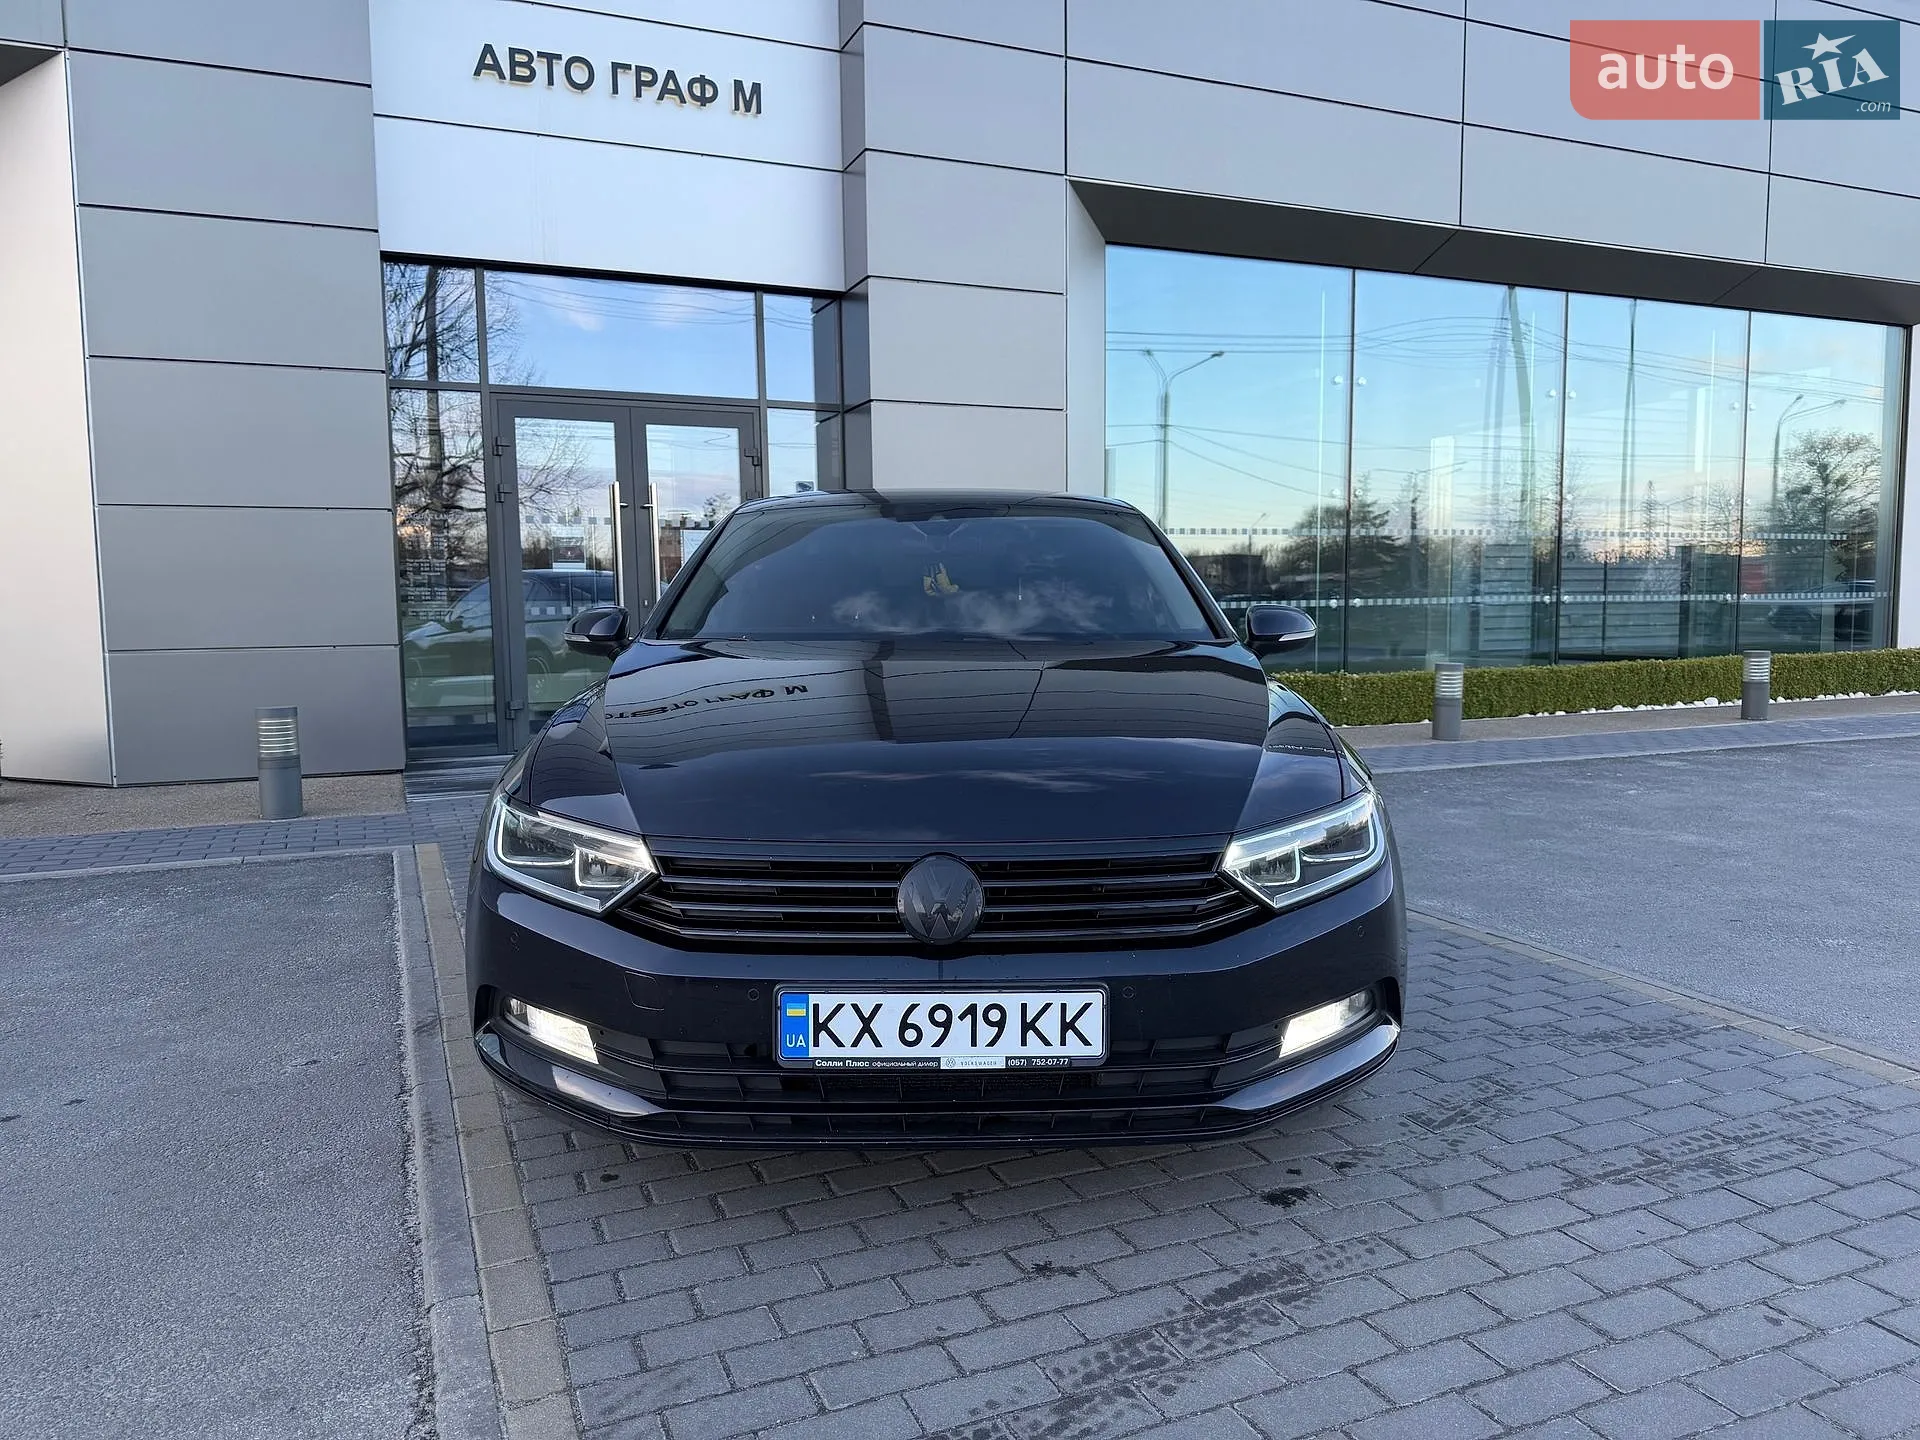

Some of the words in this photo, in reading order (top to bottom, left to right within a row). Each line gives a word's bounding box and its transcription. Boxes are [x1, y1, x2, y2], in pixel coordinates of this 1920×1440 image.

[473, 43, 595, 92] АВТО
[610, 61, 719, 107] ГРАФ
[733, 79, 762, 115] М
[786, 1034, 806, 1048] UA
[812, 1003, 884, 1048] KX
[897, 1002, 1008, 1048] 6919
[1020, 1002, 1094, 1047] KK
[815, 1059, 843, 1067] Солли
[845, 1059, 870, 1067] Плюс
[1007, 1058, 1027, 1067] (057)
[1031, 1058, 1069, 1066] 752-07-77
